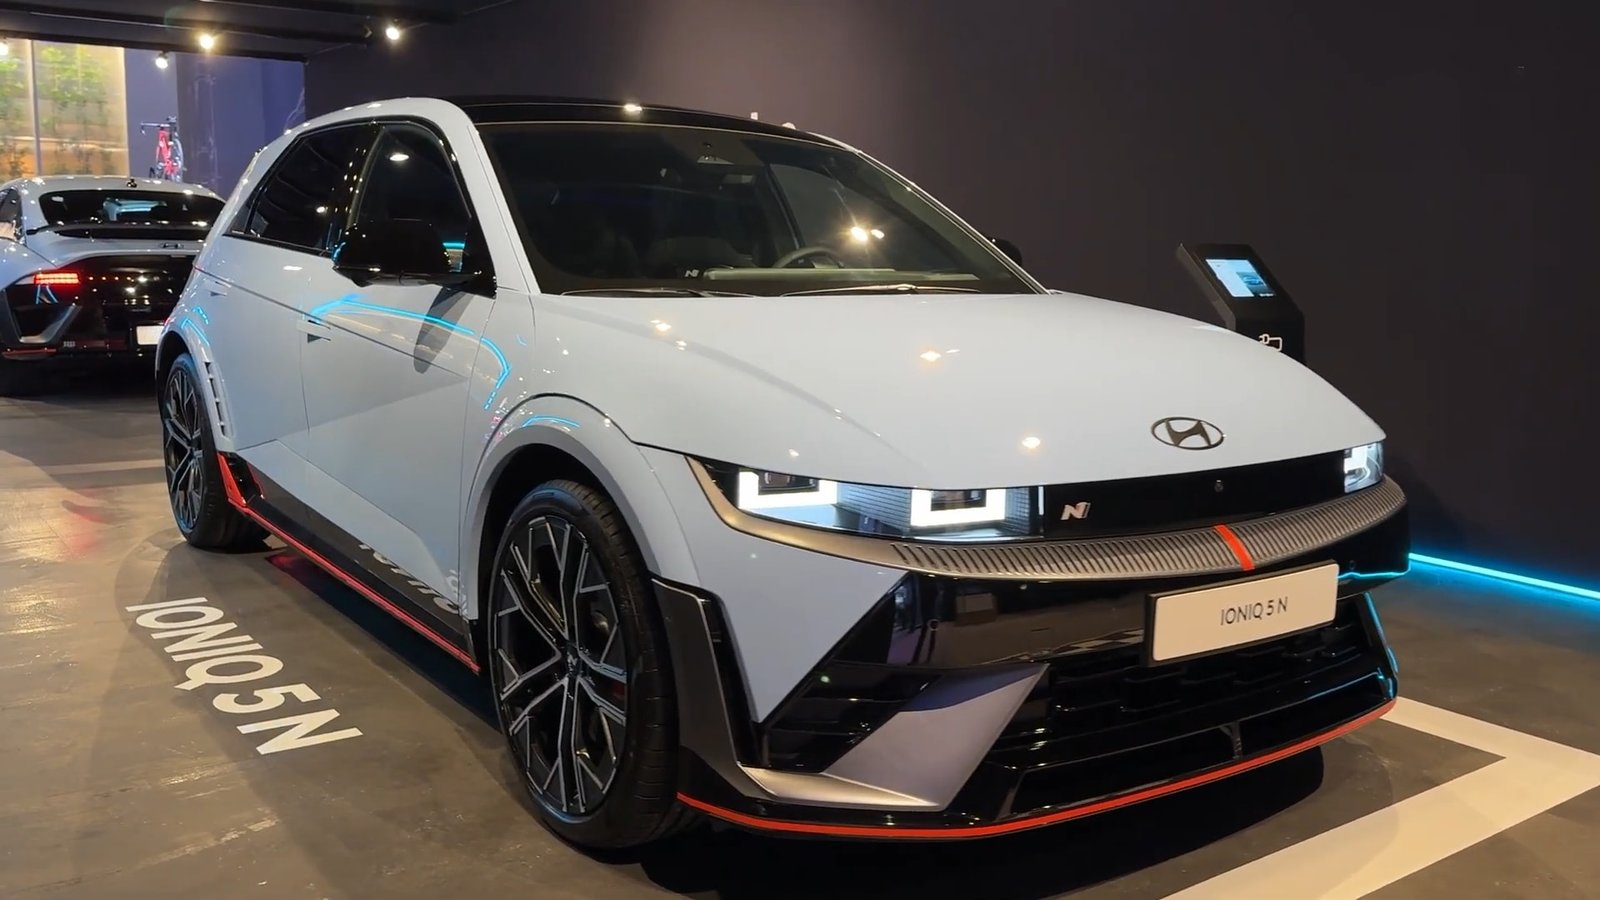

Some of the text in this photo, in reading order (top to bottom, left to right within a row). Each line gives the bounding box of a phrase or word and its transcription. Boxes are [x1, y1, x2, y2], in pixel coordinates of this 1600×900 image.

[1060, 501, 1091, 521] N
[1220, 596, 1288, 626] IONIQ 5 N
[125, 597, 364, 755] IONIQ 5 N
